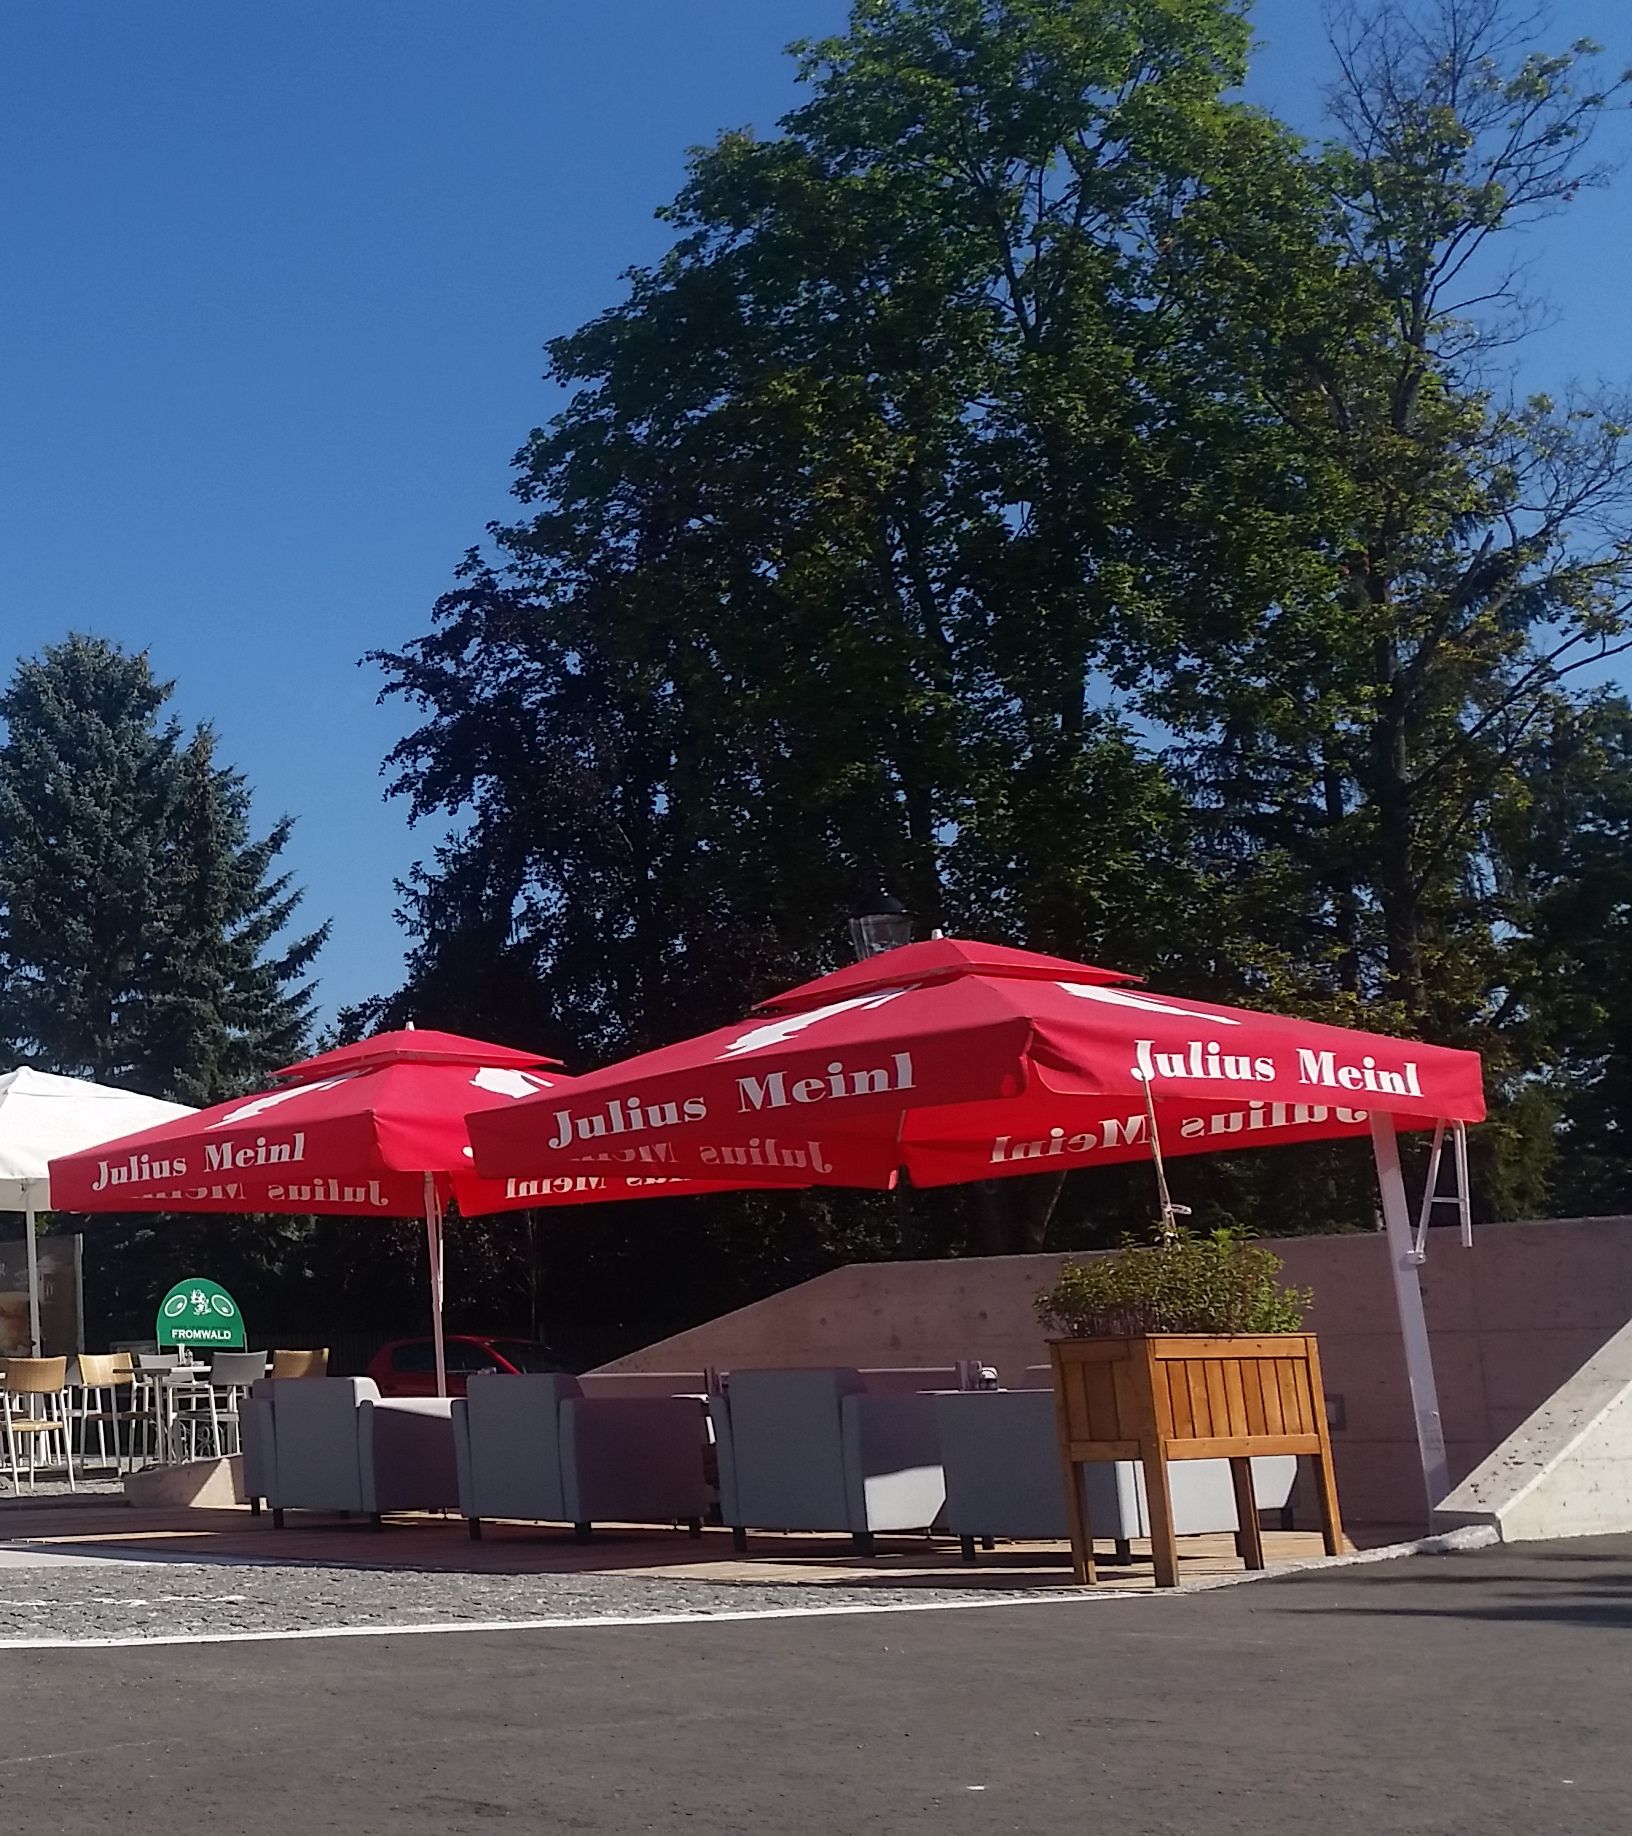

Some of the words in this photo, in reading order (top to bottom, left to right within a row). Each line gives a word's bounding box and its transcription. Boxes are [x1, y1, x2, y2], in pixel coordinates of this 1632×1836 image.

[1130, 1038, 1276, 1083] Julius
[1297, 1048, 1424, 1098] Meinl
[548, 1095, 707, 1149] Julius
[735, 1052, 917, 1113] Meinl
[92, 1153, 188, 1191] Julius
[203, 1132, 305, 1173] Meinl
[171, 1329, 232, 1340] FROMWALD
